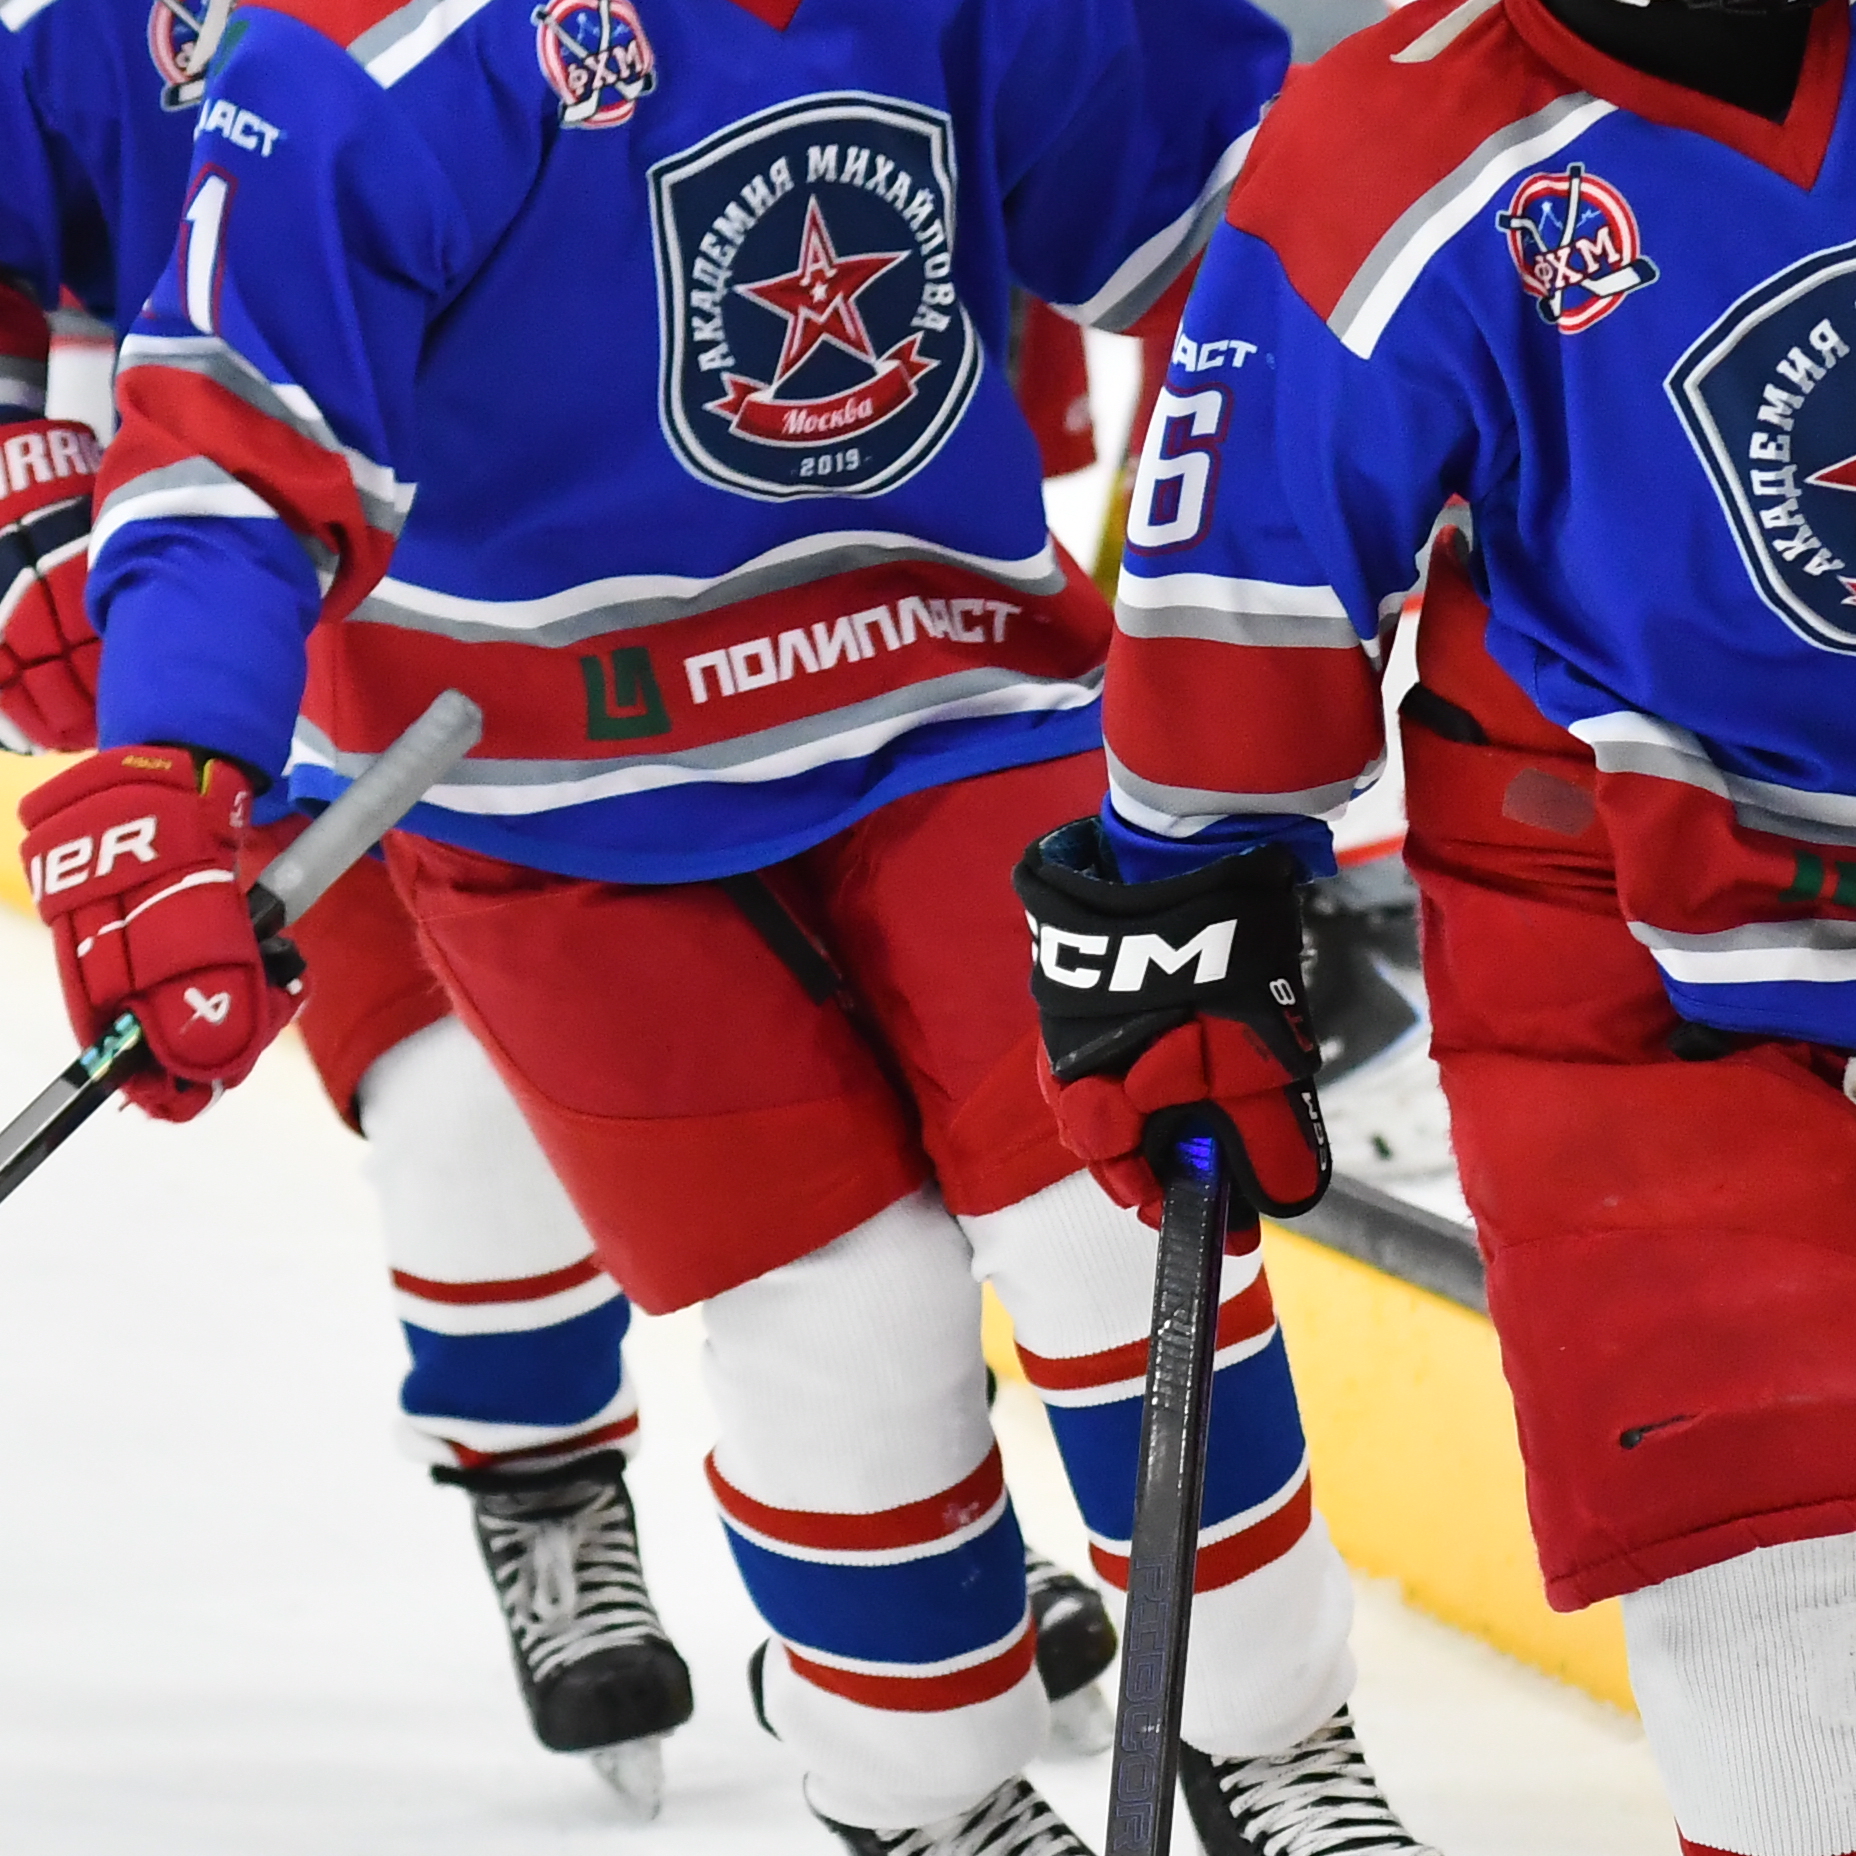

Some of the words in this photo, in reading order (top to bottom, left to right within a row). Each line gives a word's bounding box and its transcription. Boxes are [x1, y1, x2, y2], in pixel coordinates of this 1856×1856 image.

[691, 156, 795, 372] АКАДЕМИЯ
[806, 143, 956, 332] МИХАЙЛОВА
[1533, 226, 1624, 290] ФХМ
[782, 396, 875, 436] Москва
[1750, 319, 1850, 577] АКАДЕМИЯ
[684, 595, 1022, 705] ПОЛИПЛАСТ
[1024, 909, 1238, 992] CM
